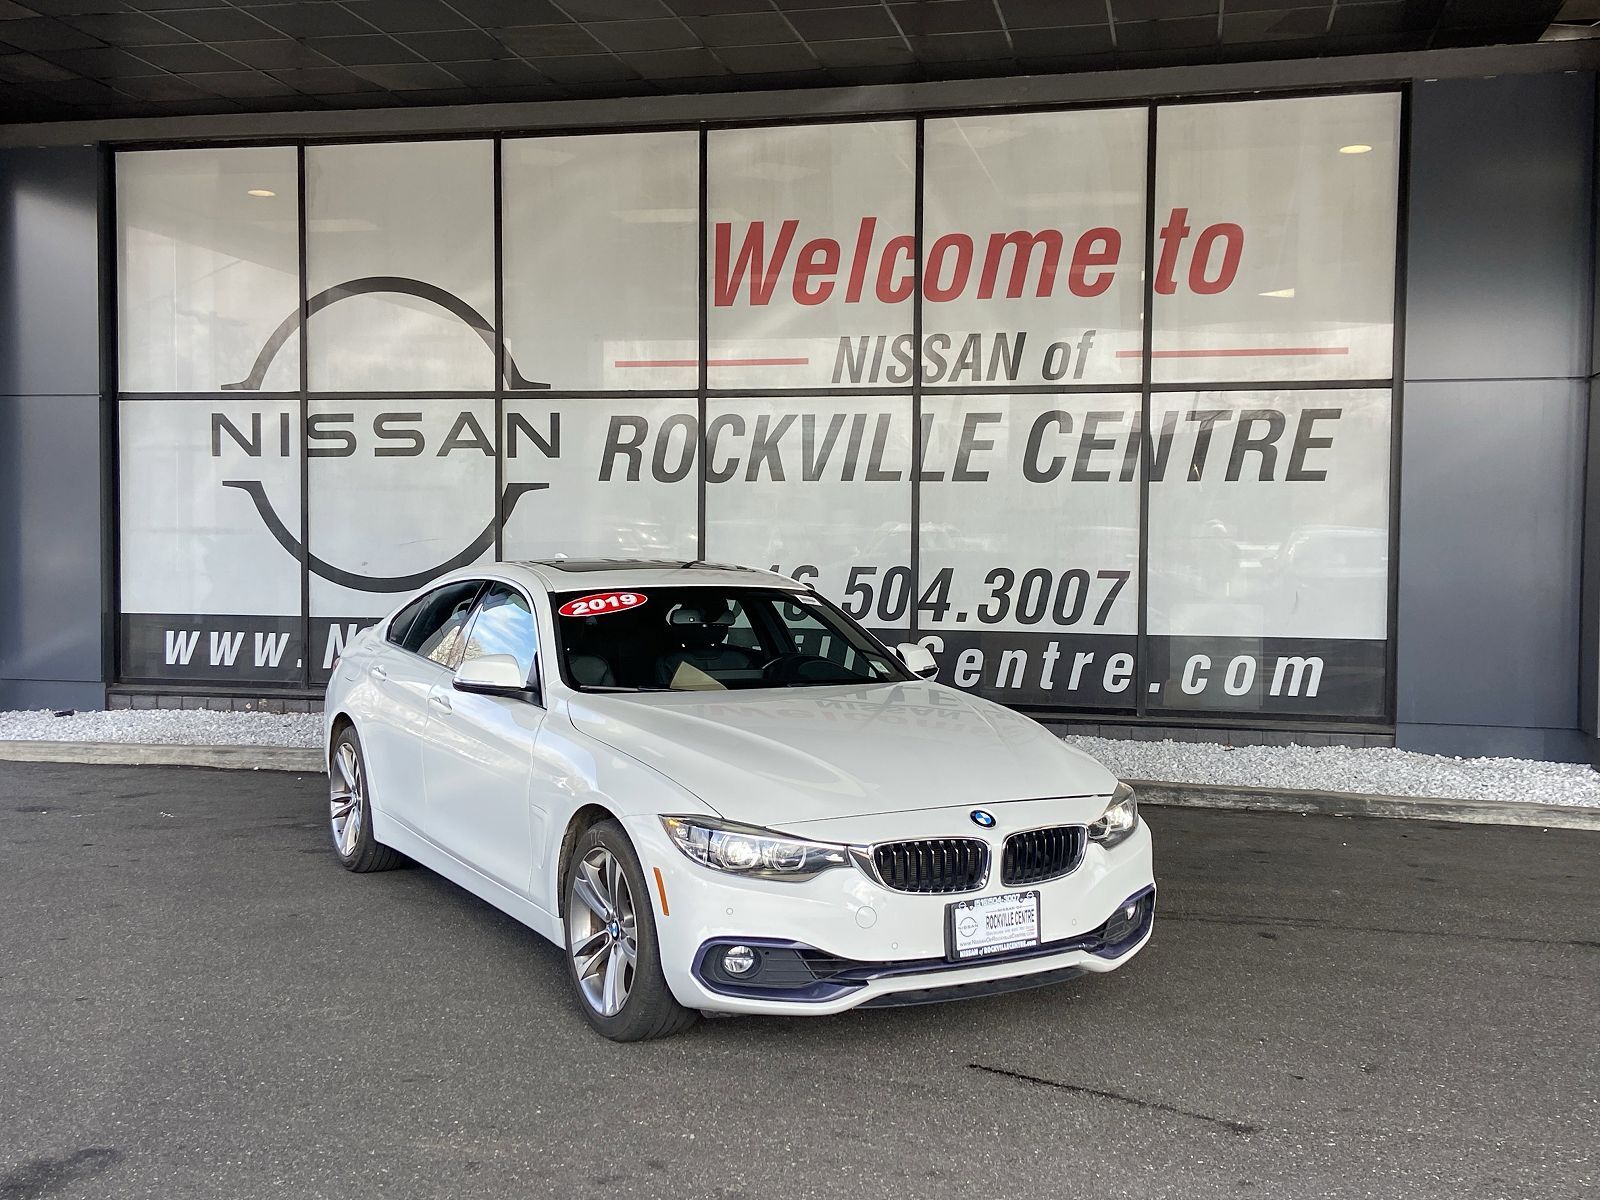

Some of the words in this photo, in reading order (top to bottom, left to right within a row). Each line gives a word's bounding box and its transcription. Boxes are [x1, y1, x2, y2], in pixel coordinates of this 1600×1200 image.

[713, 217, 1122, 307] Welcome
[1154, 207, 1245, 296] to
[831, 331, 1027, 385] NISSAN
[1042, 329, 1096, 382] of
[211, 411, 561, 459] NISSAN
[598, 411, 1008, 484] ROCKVILLE
[1022, 408, 1343, 483] CENTRE
[571, 594, 638, 615] 2019
[986, 911, 1014, 930] ROCKVILLE
[1014, 908, 1035, 926] CENTRE
